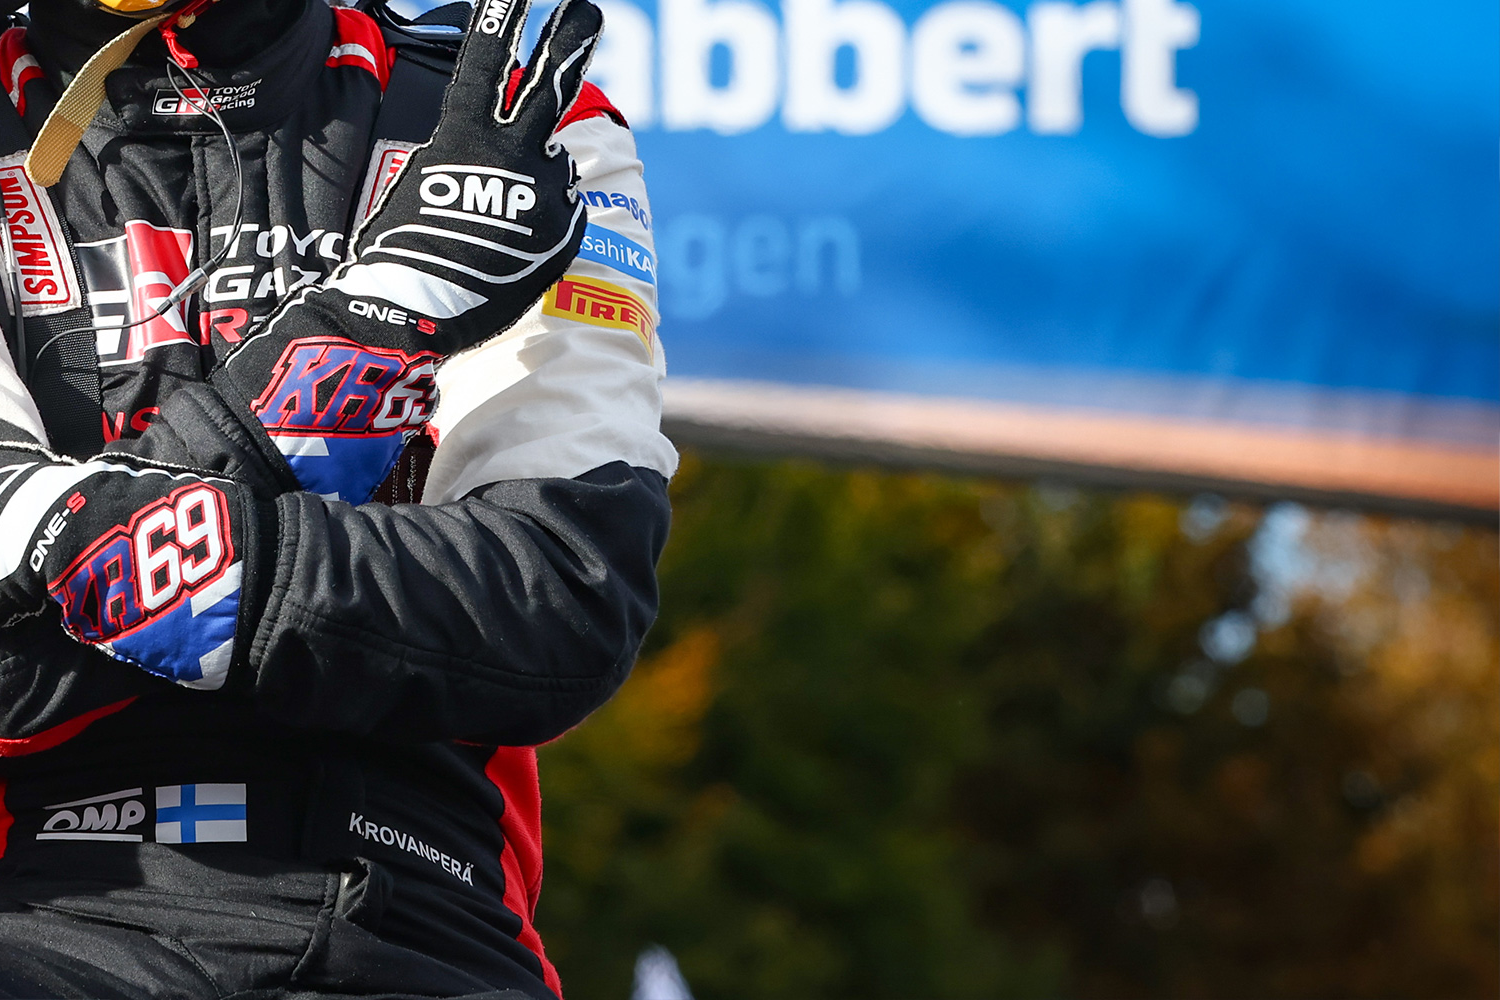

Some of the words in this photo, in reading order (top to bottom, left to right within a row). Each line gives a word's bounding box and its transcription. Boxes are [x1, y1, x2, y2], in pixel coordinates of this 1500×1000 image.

[210, 88, 256, 104] GAZOO
[213, 79, 262, 95] TOYOTA
[155, 97, 207, 113] GR
[419, 173, 537, 220] OMP
[348, 300, 436, 335] ONE-S
[555, 280, 655, 346] PIREL
[28, 490, 87, 573] ONE-S
[42, 799, 146, 831] OMP
